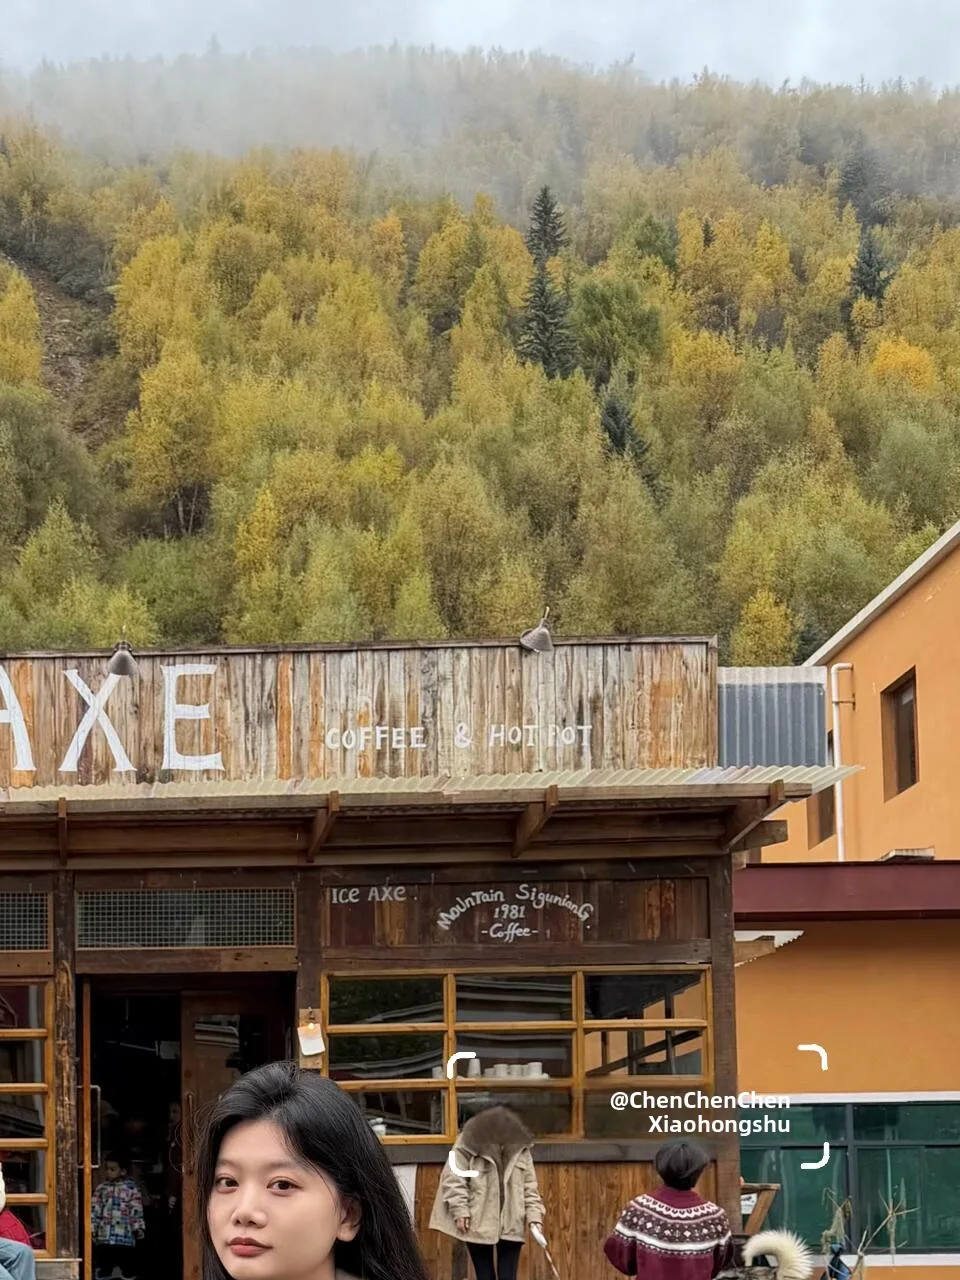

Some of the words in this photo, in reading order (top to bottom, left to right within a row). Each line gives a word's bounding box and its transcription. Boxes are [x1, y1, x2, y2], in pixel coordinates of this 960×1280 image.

[324, 726, 427, 750] COFFEE
[453, 722, 475, 749] &
[489, 723, 539, 748] HOT
[493, 903, 526, 919] 1981
